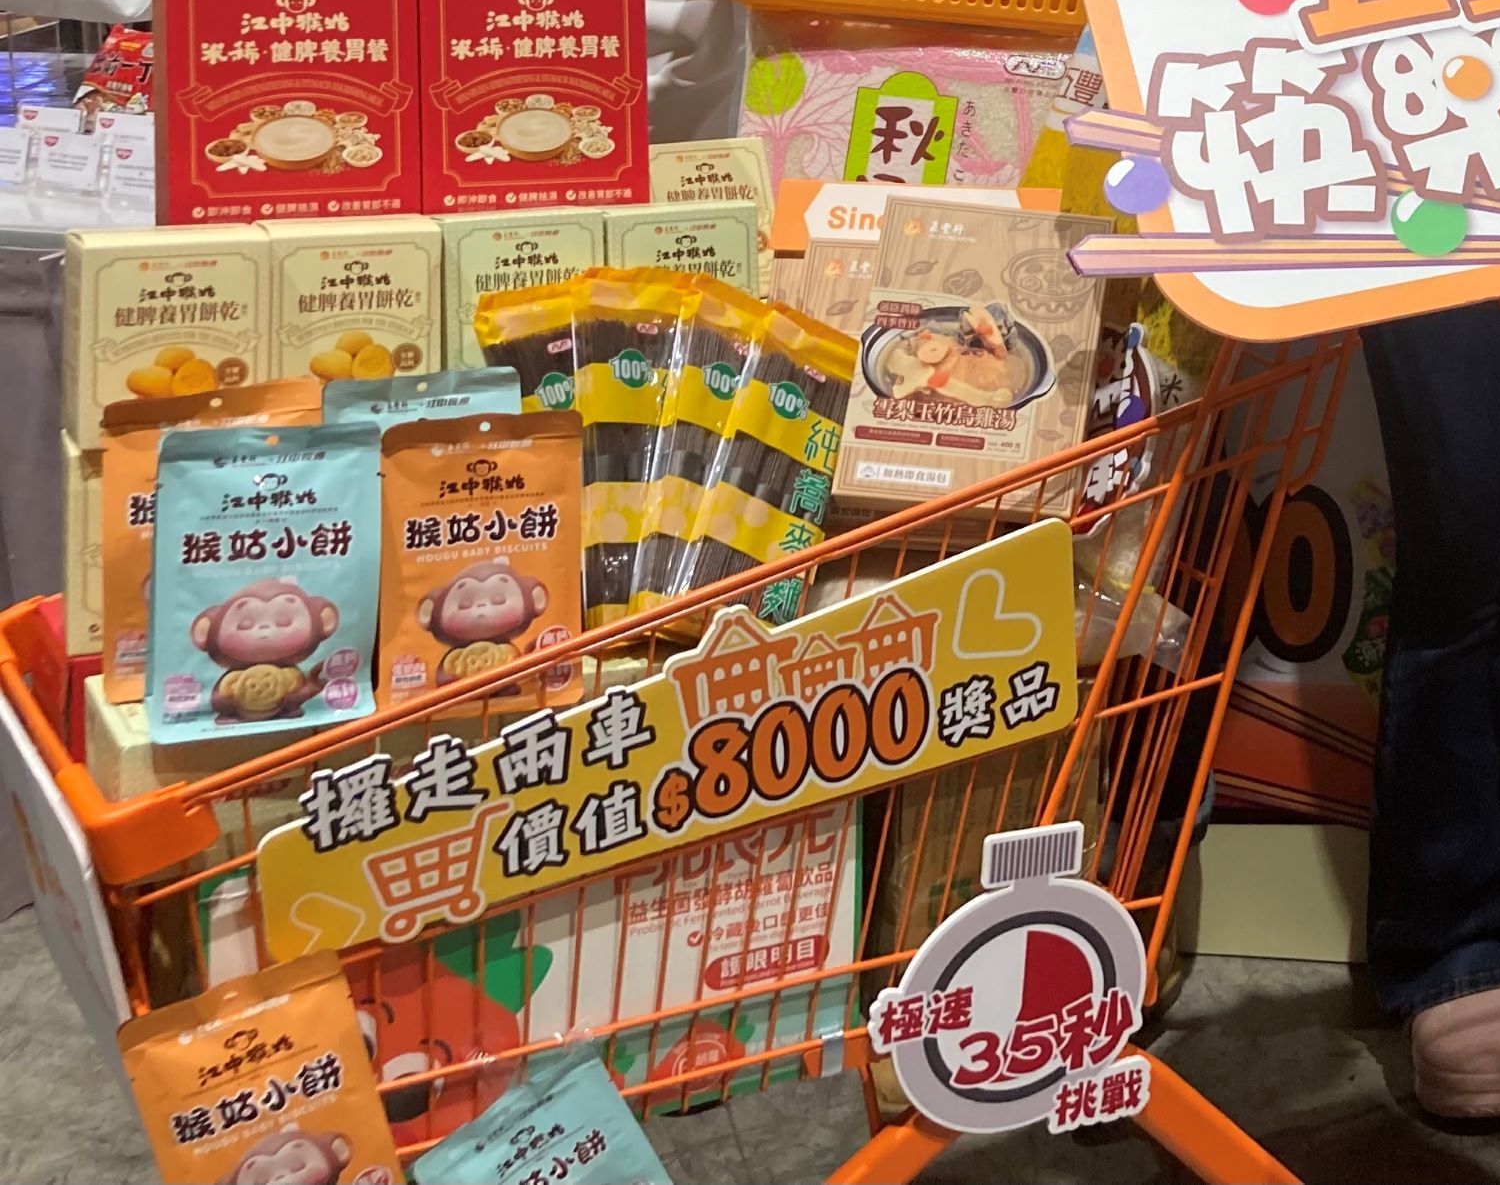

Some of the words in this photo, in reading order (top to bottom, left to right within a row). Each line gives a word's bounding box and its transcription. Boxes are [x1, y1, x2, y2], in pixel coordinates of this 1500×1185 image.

[767, 381, 809, 420] 100%
[181, 519, 353, 566] 猴姑小餅
[404, 504, 559, 550] 猴姑小餅
[416, 551, 460, 564] HOUGU
[462, 547, 491, 560] BABY
[298, 684, 655, 853] 攞走兩車
[496, 782, 645, 882] 價值
[652, 668, 933, 835] $8000
[938, 665, 1061, 748] 獎品
[878, 985, 975, 1047] 極速
[952, 989, 1134, 1087] 35秒
[1055, 1069, 1144, 1127] 挑戰
